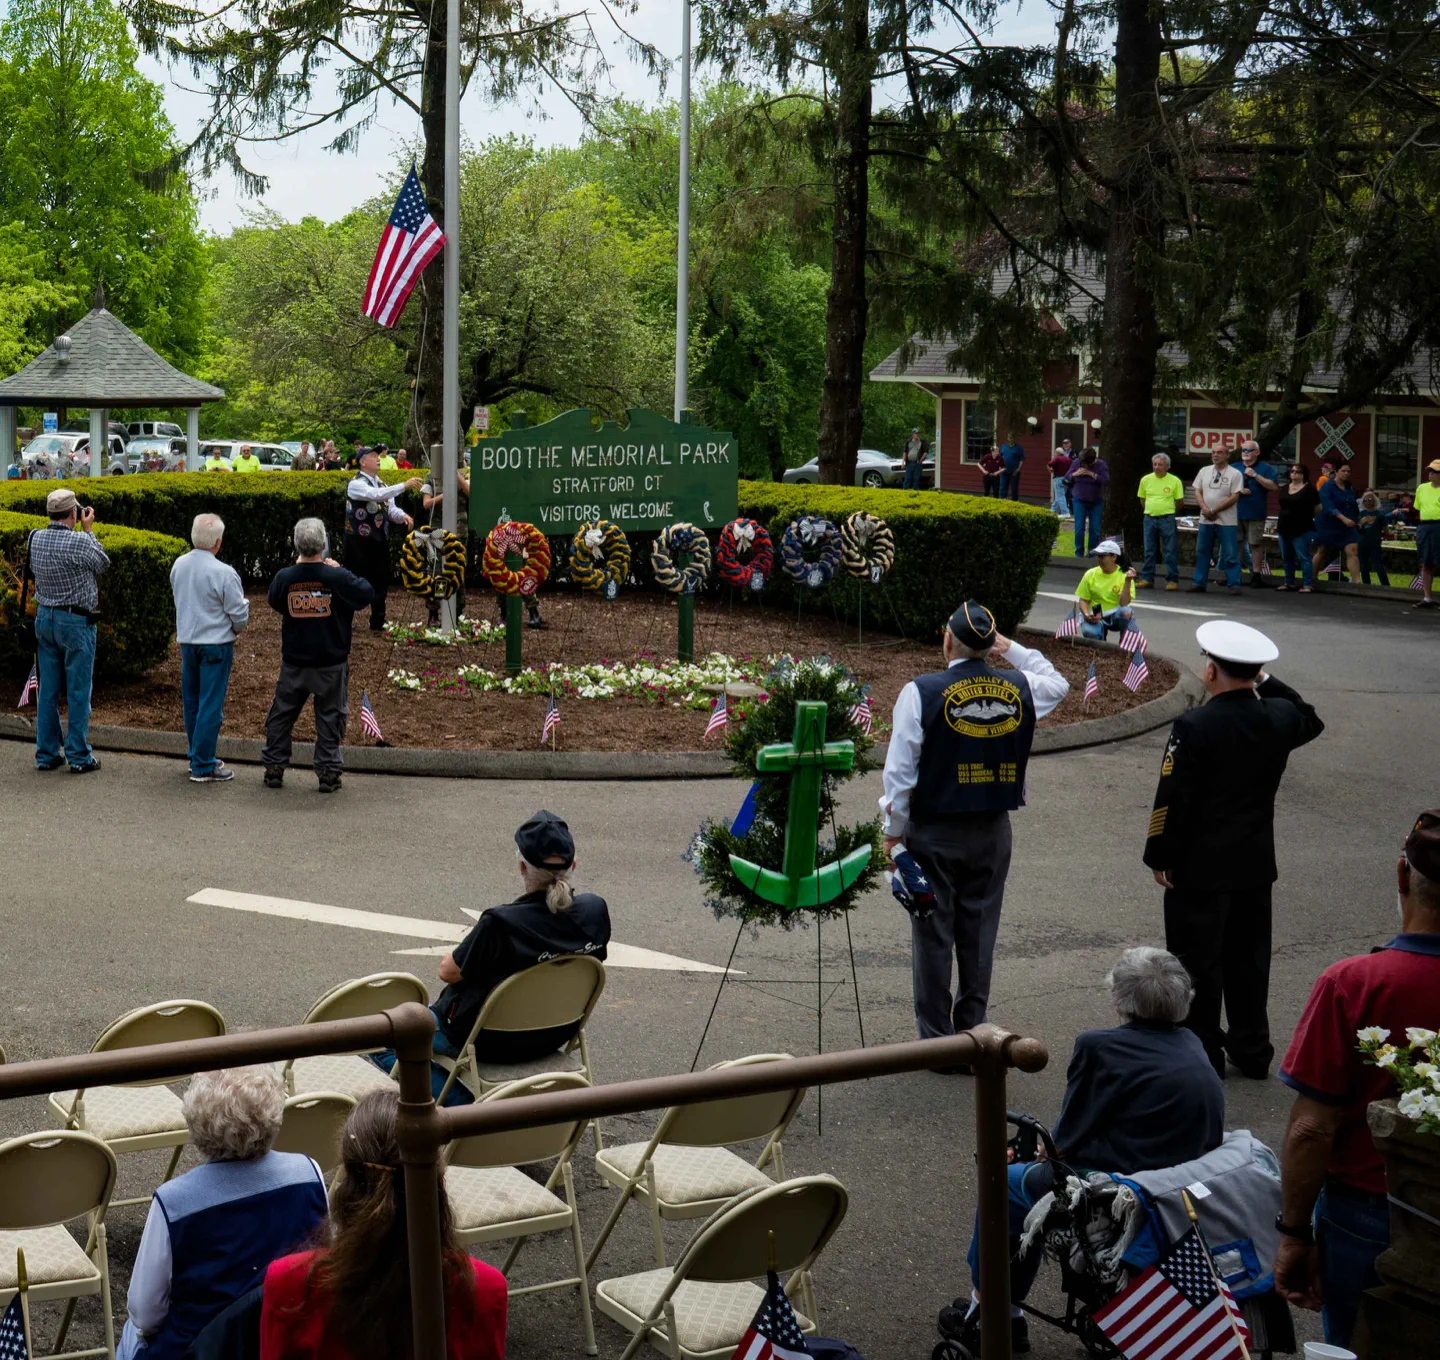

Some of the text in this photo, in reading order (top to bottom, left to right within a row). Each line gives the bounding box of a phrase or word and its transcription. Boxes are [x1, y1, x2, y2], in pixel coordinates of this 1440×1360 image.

[1191, 431, 1252, 449] OPEN
[481, 442, 730, 470] BOOTHE MEMORIAL PARK
[552, 475, 664, 494] STRATFORD CT
[539, 501, 674, 523] VISITORS WELCOME
[293, 596, 330, 609] DOVER
[941, 678, 972, 697] HUDSON
[973, 676, 1001, 684] VALLEY
[956, 686, 1010, 699] UNITED STATES
